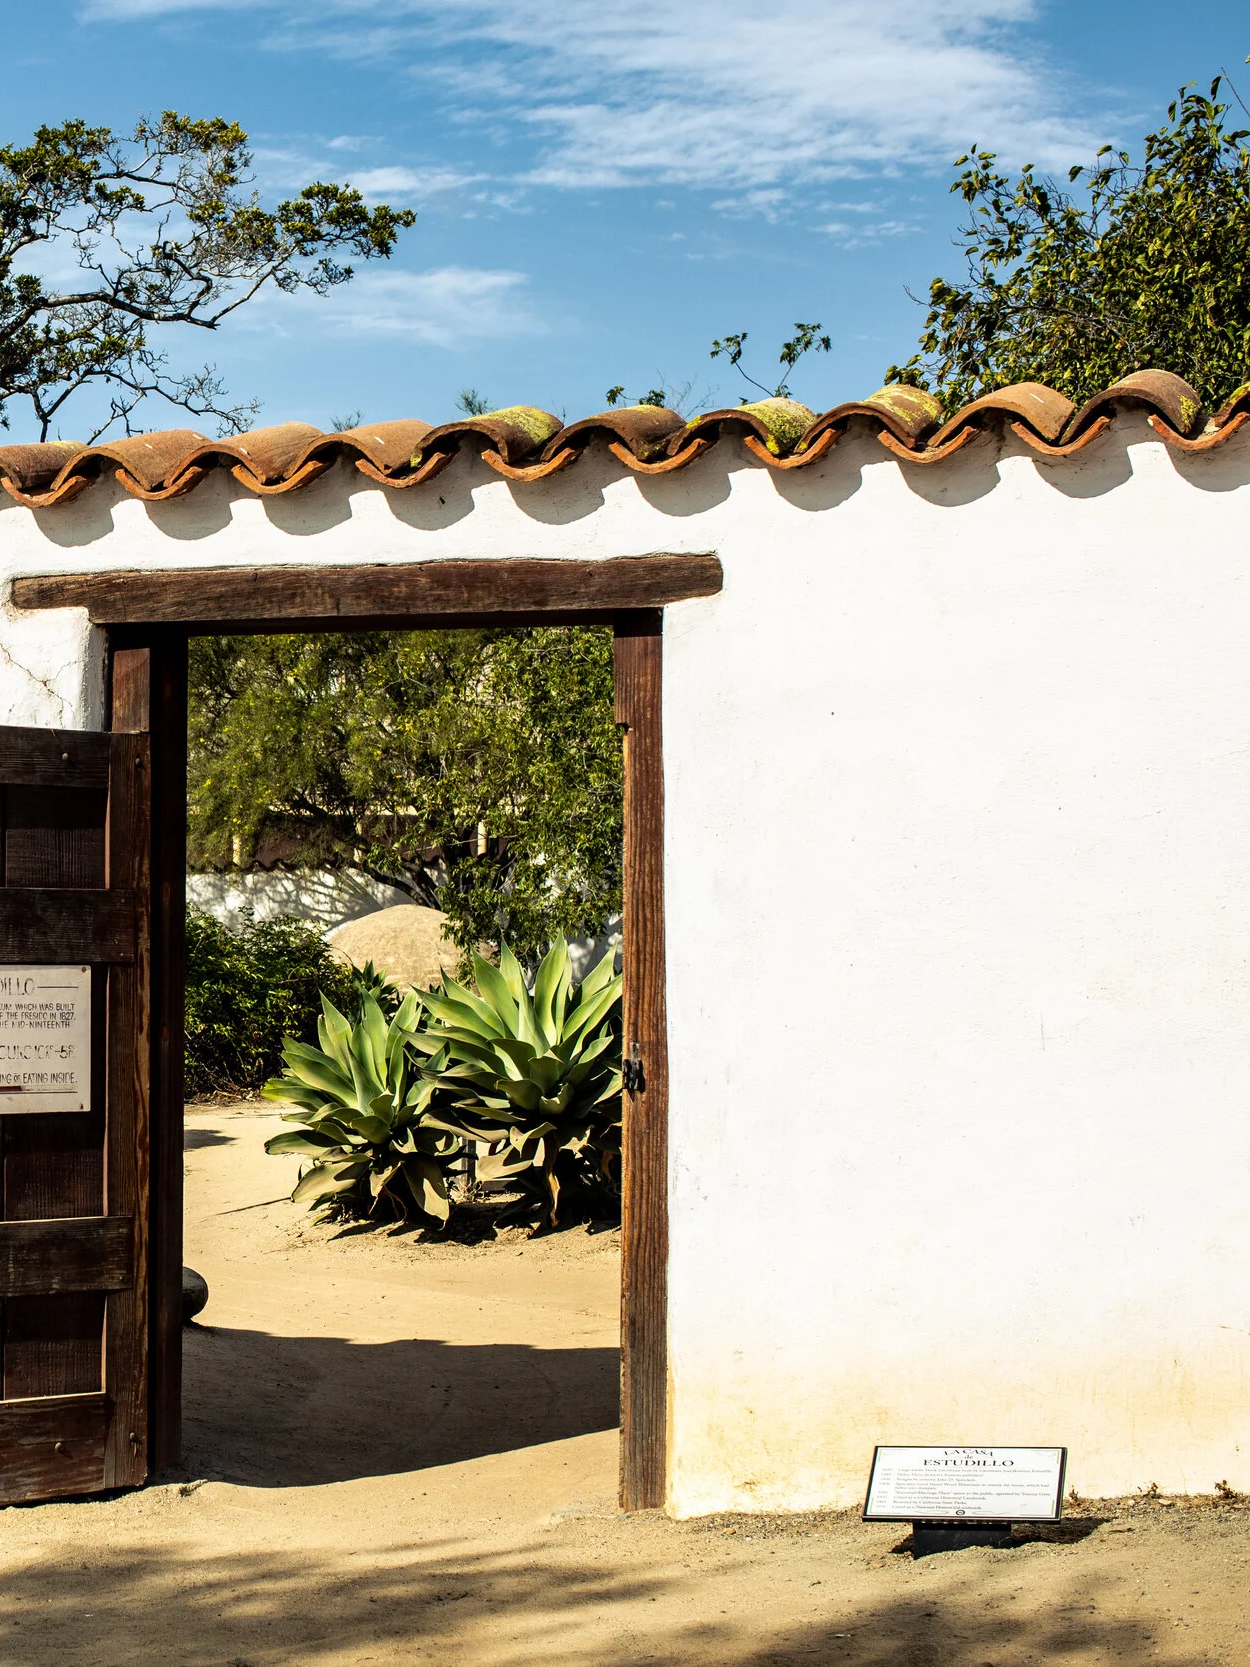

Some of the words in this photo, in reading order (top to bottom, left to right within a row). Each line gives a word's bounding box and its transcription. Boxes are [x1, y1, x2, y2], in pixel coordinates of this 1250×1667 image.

[15, 1003, 37, 1011] WHICH
[39, 1003, 54, 1011] WAS
[56, 1003, 75, 1011] BUILT
[6, 1012, 19, 1020] THE
[49, 1012, 57, 1020] IN
[22, 1072, 49, 1084] EATING
[962, 1448, 994, 1457] CASA
[923, 1459, 1015, 1467] ESTUDILLO
